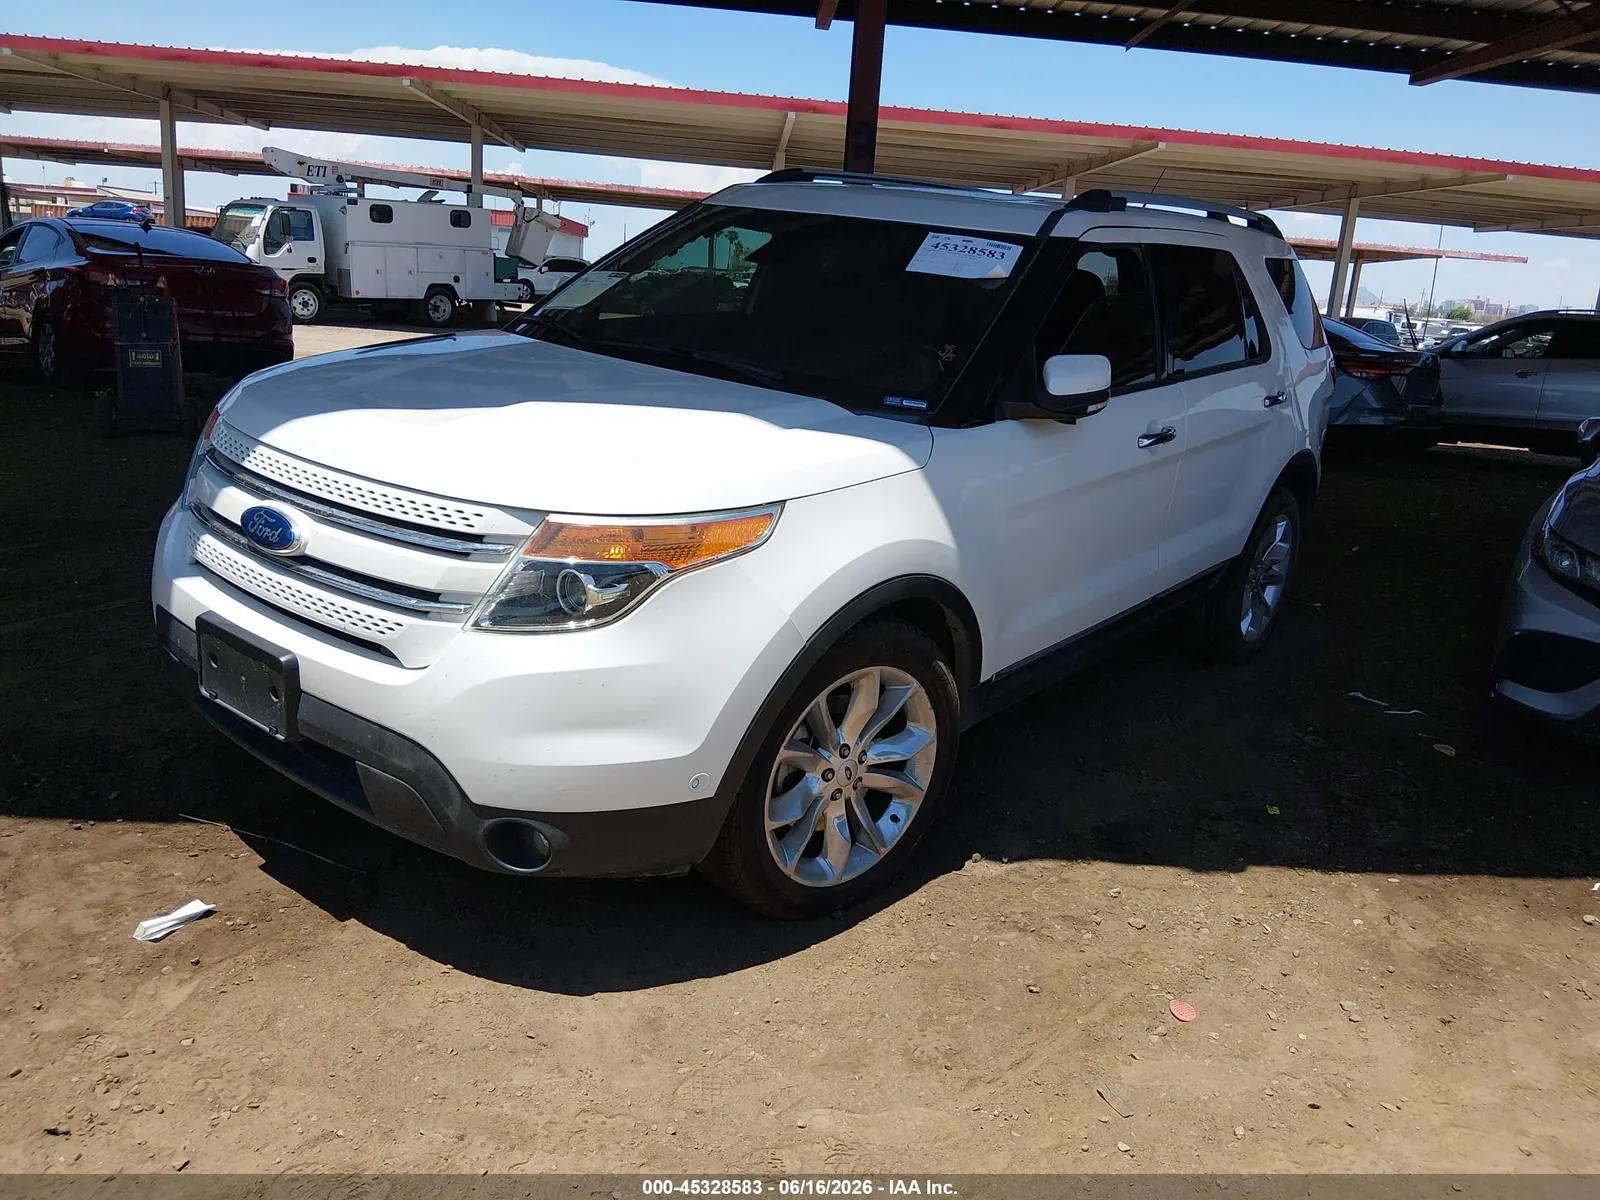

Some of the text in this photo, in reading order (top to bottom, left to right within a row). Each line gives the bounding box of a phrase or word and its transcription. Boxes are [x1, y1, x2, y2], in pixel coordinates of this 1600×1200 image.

[306, 164, 328, 177] ETI
[930, 241, 1006, 261] 45328583
[248, 510, 283, 543] Ford
